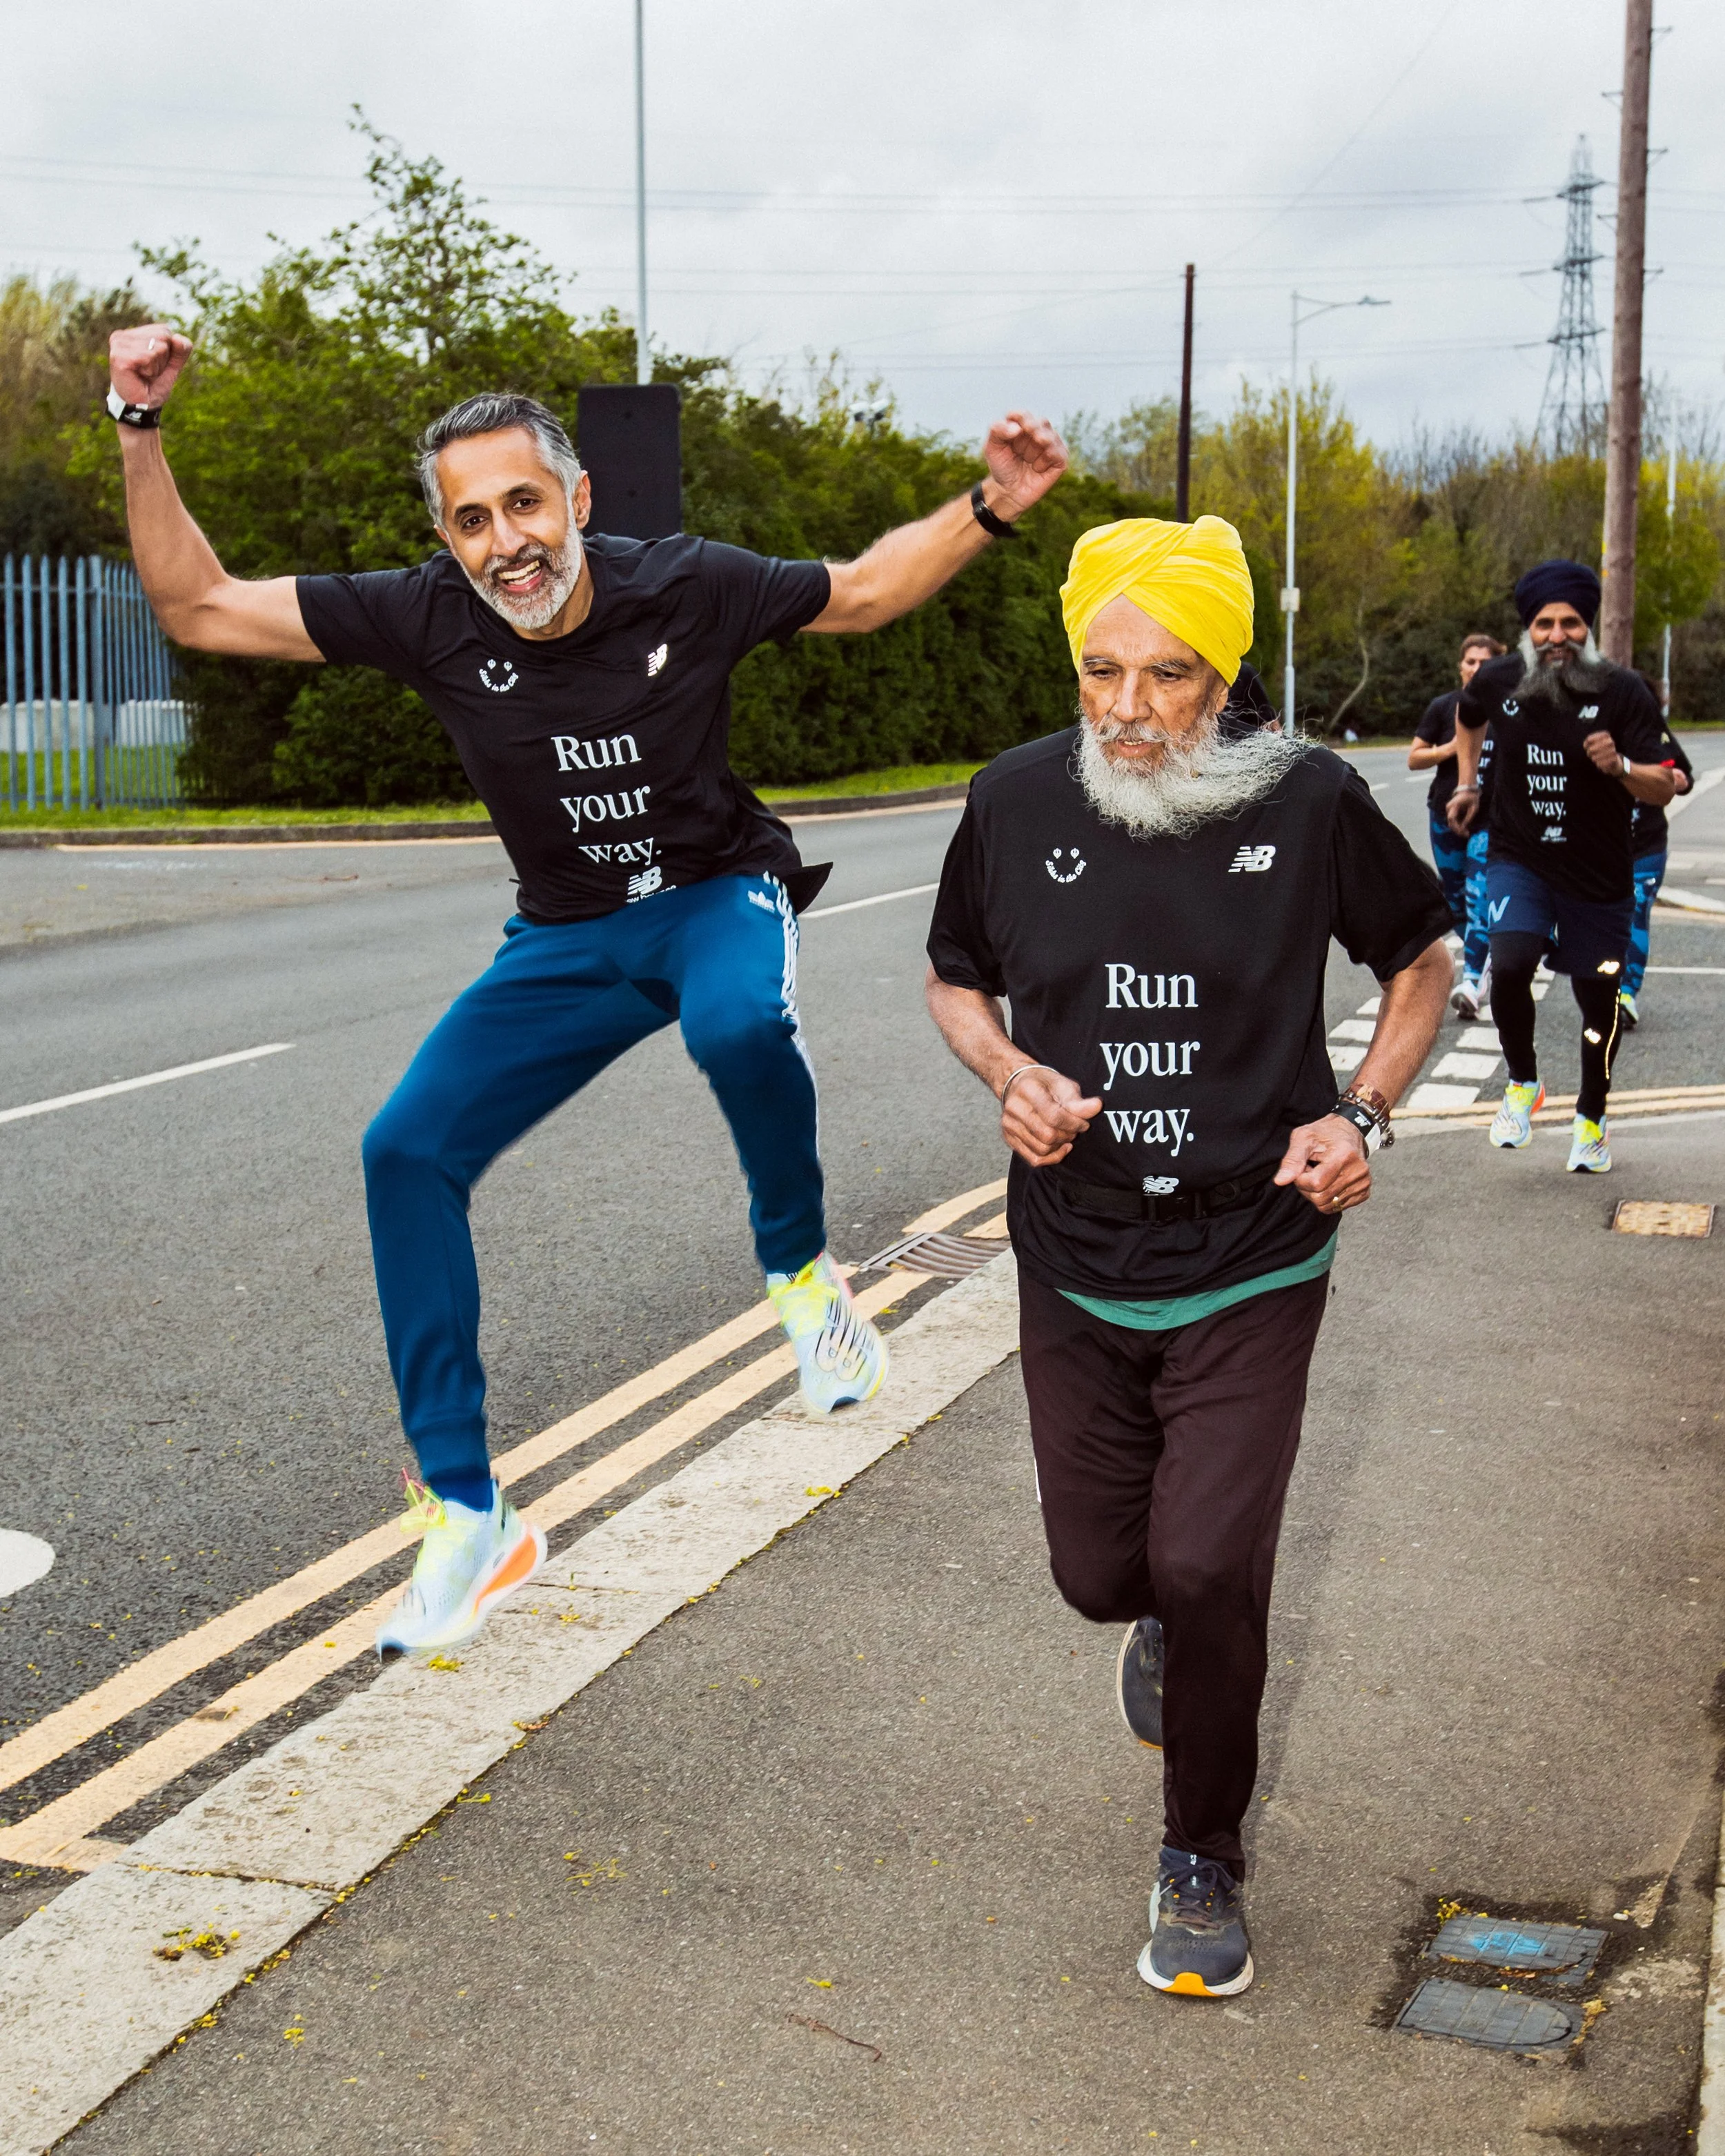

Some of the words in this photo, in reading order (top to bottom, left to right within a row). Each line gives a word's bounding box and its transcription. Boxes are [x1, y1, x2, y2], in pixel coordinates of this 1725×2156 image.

[550, 734, 642, 771] Run
[1526, 743, 1564, 766] Run
[1526, 774, 1567, 795] your
[560, 785, 651, 833] your
[1530, 800, 1566, 821] way.
[578, 837, 662, 867] way.
[1105, 963, 1199, 1009] Run
[1099, 1041, 1201, 1091] your
[1104, 1109, 1194, 1157] way.
